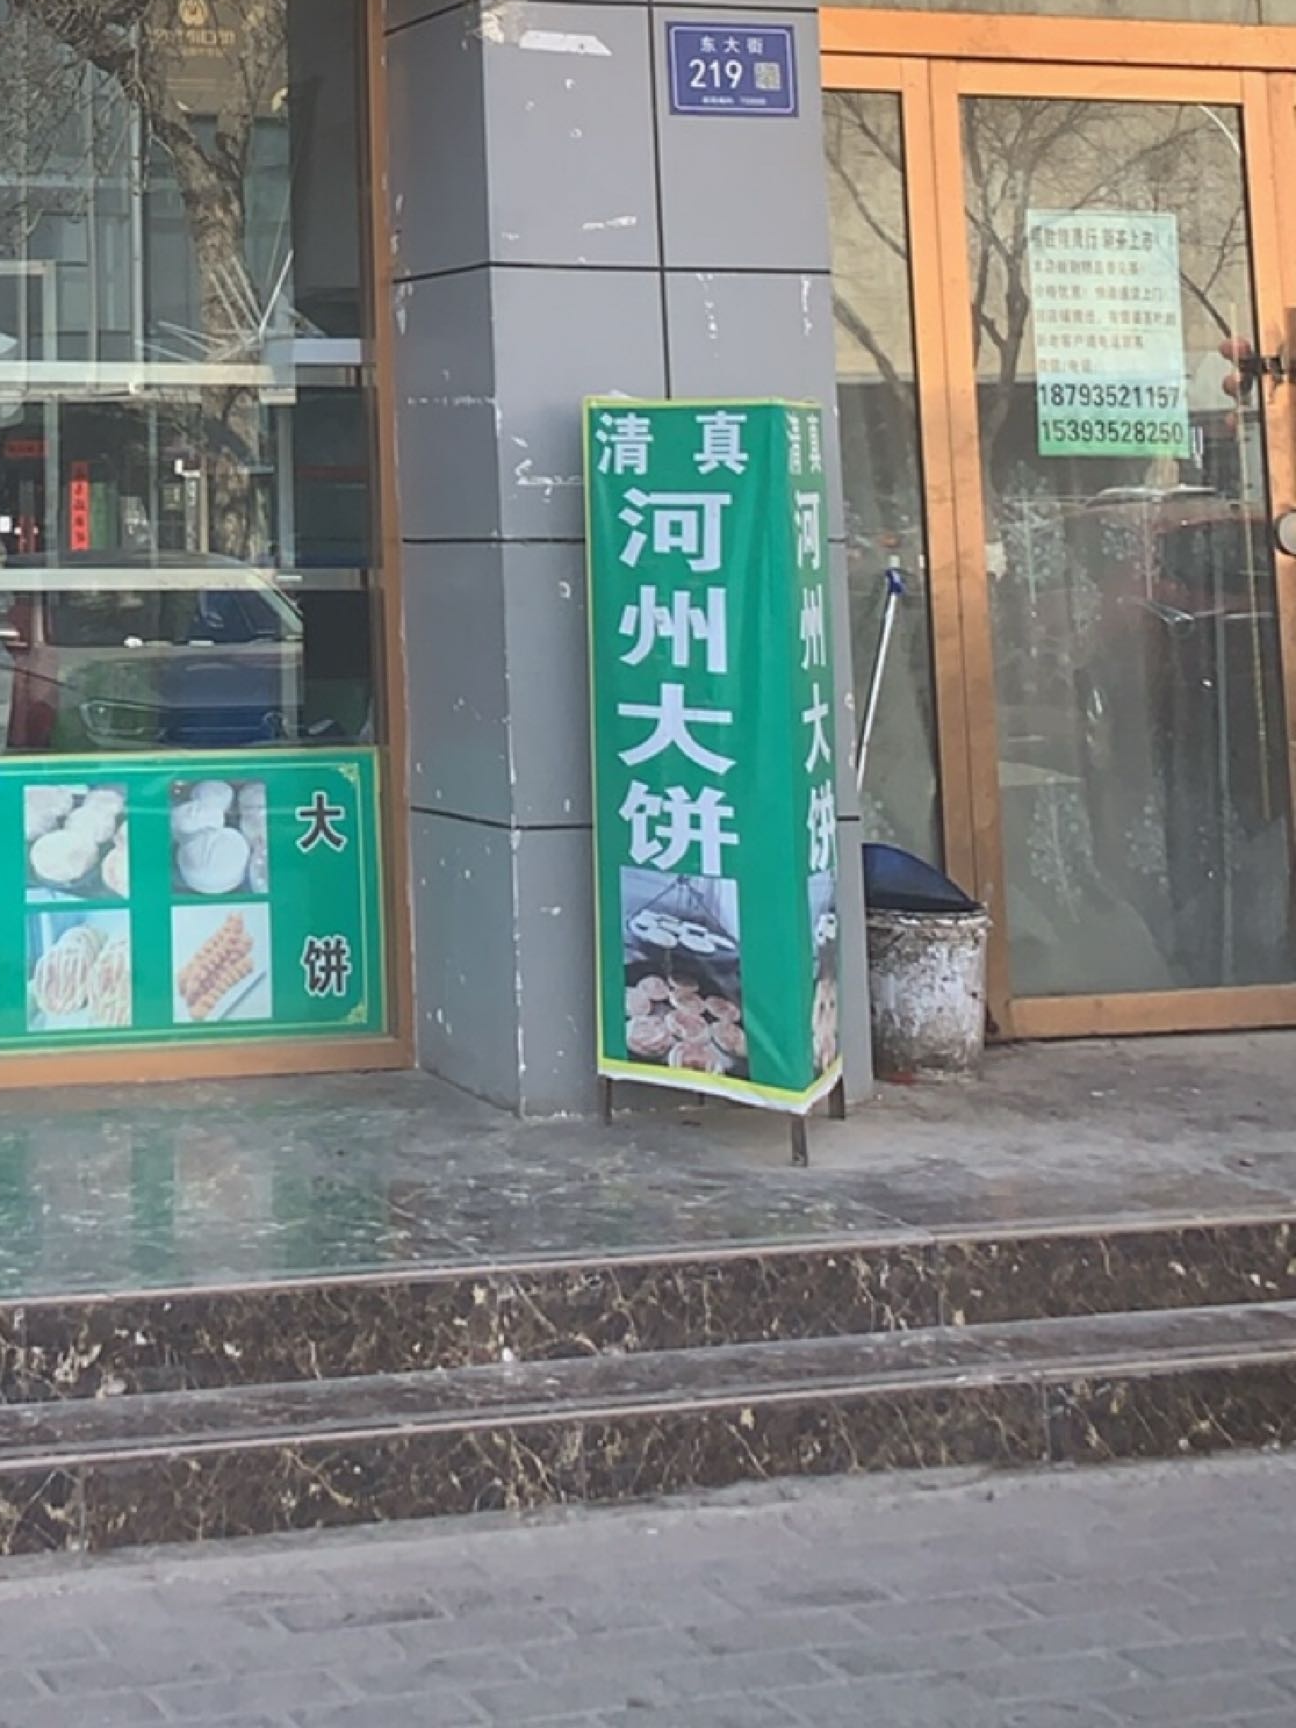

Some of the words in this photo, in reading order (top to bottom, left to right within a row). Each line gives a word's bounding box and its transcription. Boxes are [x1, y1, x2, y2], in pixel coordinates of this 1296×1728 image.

[700, 35, 764, 54] 东大街
[689, 59, 742, 89] 219
[1039, 383, 1180, 409] 18793521157
[595, 410, 749, 476] 清真
[1042, 419, 1184, 445] 15393528250
[617, 487, 740, 876] 河州大饼
[296, 792, 353, 998] 大饼
